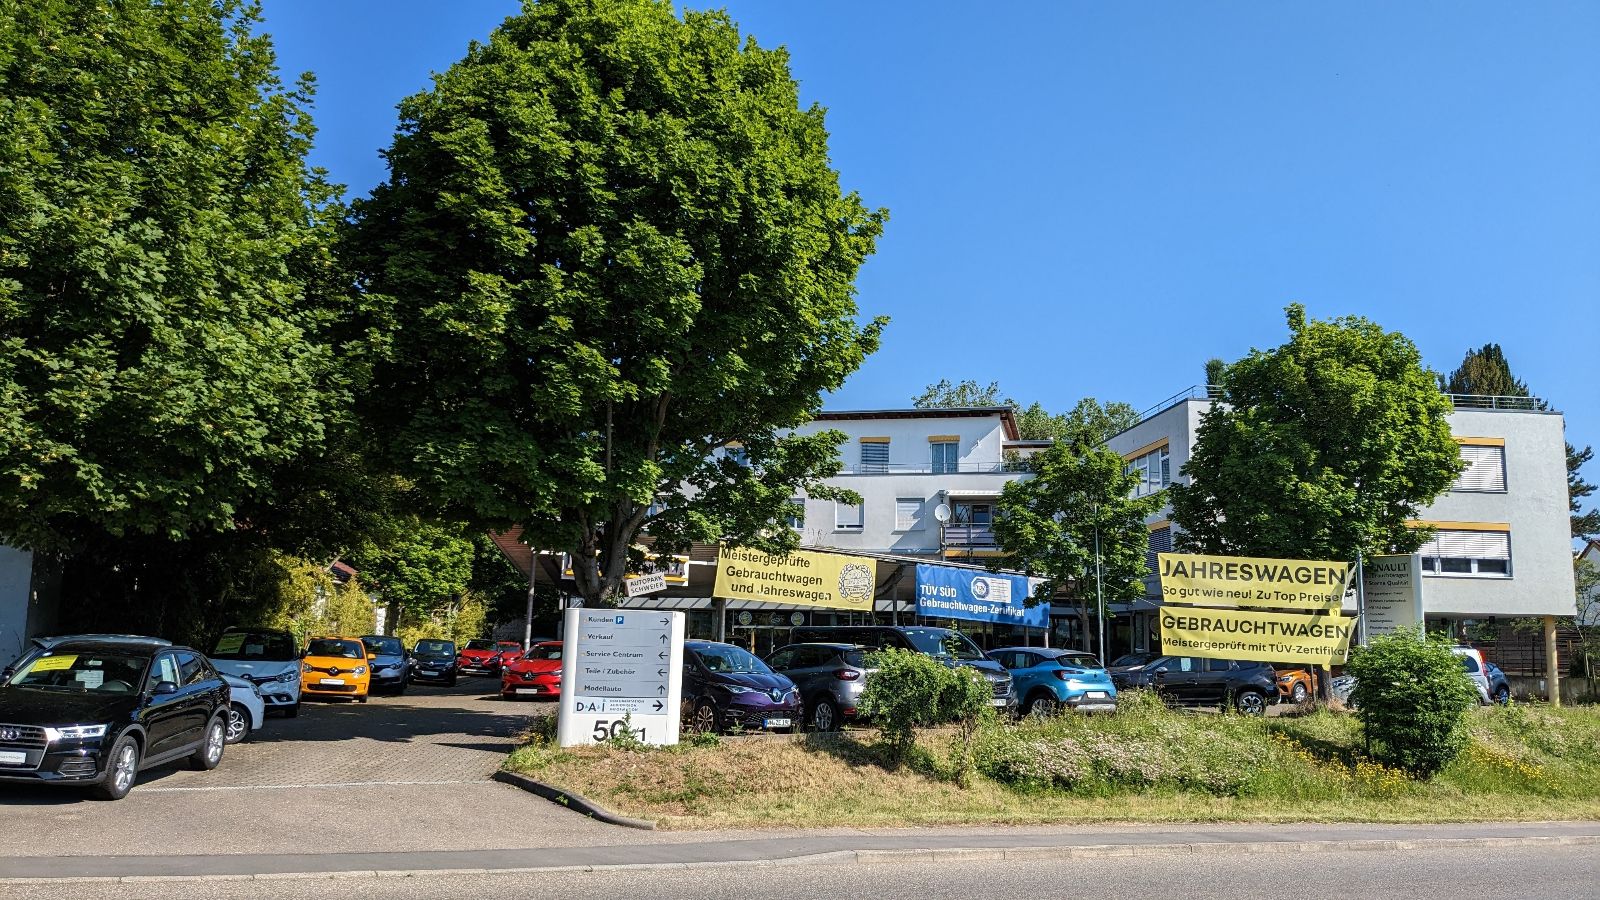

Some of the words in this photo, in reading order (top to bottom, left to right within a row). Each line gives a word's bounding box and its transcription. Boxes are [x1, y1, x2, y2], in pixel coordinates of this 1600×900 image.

[720, 549, 810, 568] Meistergeprüfte
[1373, 562, 1408, 571] NAULT
[630, 575, 663, 587] AUTOPARK
[726, 566, 823, 587] Gebrauchtwagen
[1161, 559, 1347, 585] JAHRESWAGEN
[630, 582, 664, 594] SCHWEIER
[731, 583, 754, 594] und
[757, 584, 832, 602] Jahreswagen
[919, 584, 938, 596] TÜV
[939, 585, 957, 598] SÜD
[1162, 586, 1177, 596] So
[1179, 587, 1200, 598] gut
[1202, 588, 1224, 598] wie
[1226, 589, 1252, 599] neu!
[1256, 590, 1272, 600] Zu
[1274, 591, 1297, 603] Top
[919, 597, 1025, 617] Gebrauchtwagen-Zertifikat
[1162, 615, 1349, 639] GEBRAUCHTWAGEN
[1162, 637, 1247, 652] Meistergeprüft
[1248, 642, 1267, 652] mit
[584, 684, 622, 692] Modellauto
[592, 719, 646, 742] 501
